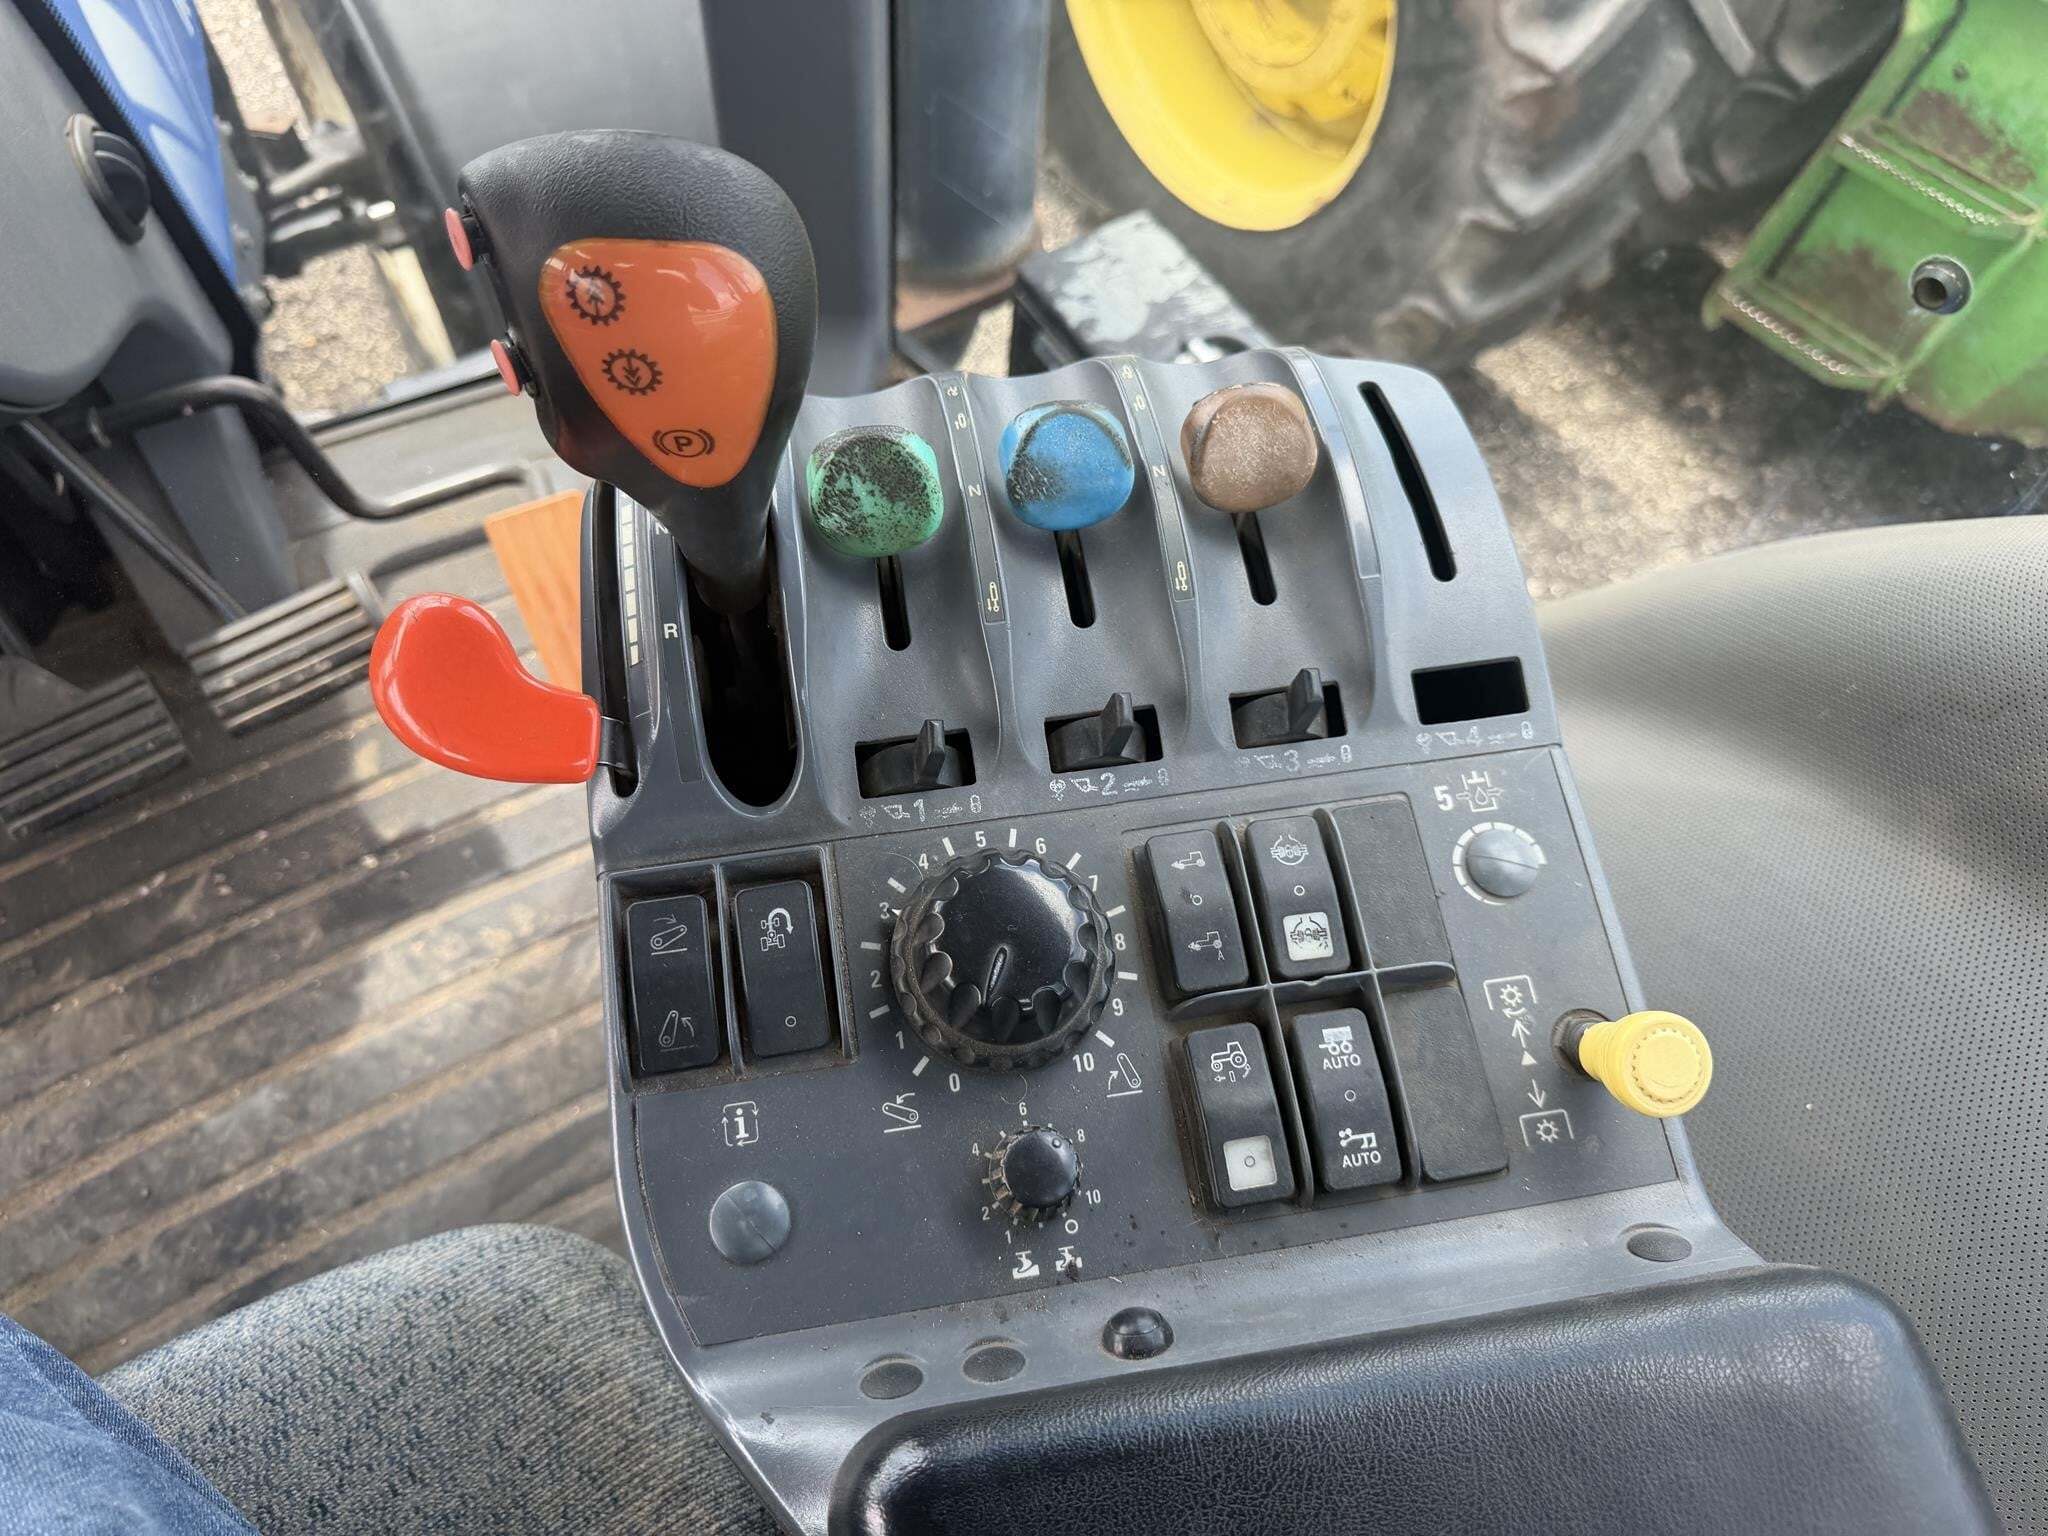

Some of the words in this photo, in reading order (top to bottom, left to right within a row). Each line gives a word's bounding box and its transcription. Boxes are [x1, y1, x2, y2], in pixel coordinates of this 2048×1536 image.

[663, 623, 679, 639] R
[1100, 772, 1118, 796] 2
[1433, 786, 1454, 812] 5
[913, 799, 926, 822] 1
[975, 831, 987, 848] 5
[1035, 837, 1047, 855] 6
[918, 853, 929, 870] 4
[1088, 875, 1099, 893] 7
[879, 902, 890, 920] 3
[1115, 933, 1126, 951] 8
[870, 970, 882, 989] 2
[1112, 998, 1124, 1017] 9
[895, 1031, 905, 1050] 1
[1072, 1052, 1095, 1073] 10
[1322, 1053, 1361, 1071] AUTO
[949, 1073, 960, 1093] 0
[1018, 1101, 1027, 1116] 6
[1077, 1128, 1086, 1142] 8
[972, 1142, 980, 1157] 4
[1342, 1150, 1381, 1169] AUTO
[1085, 1189, 1102, 1205] 10
[981, 1206, 990, 1221] 2
[1004, 1229, 1012, 1244] 1
